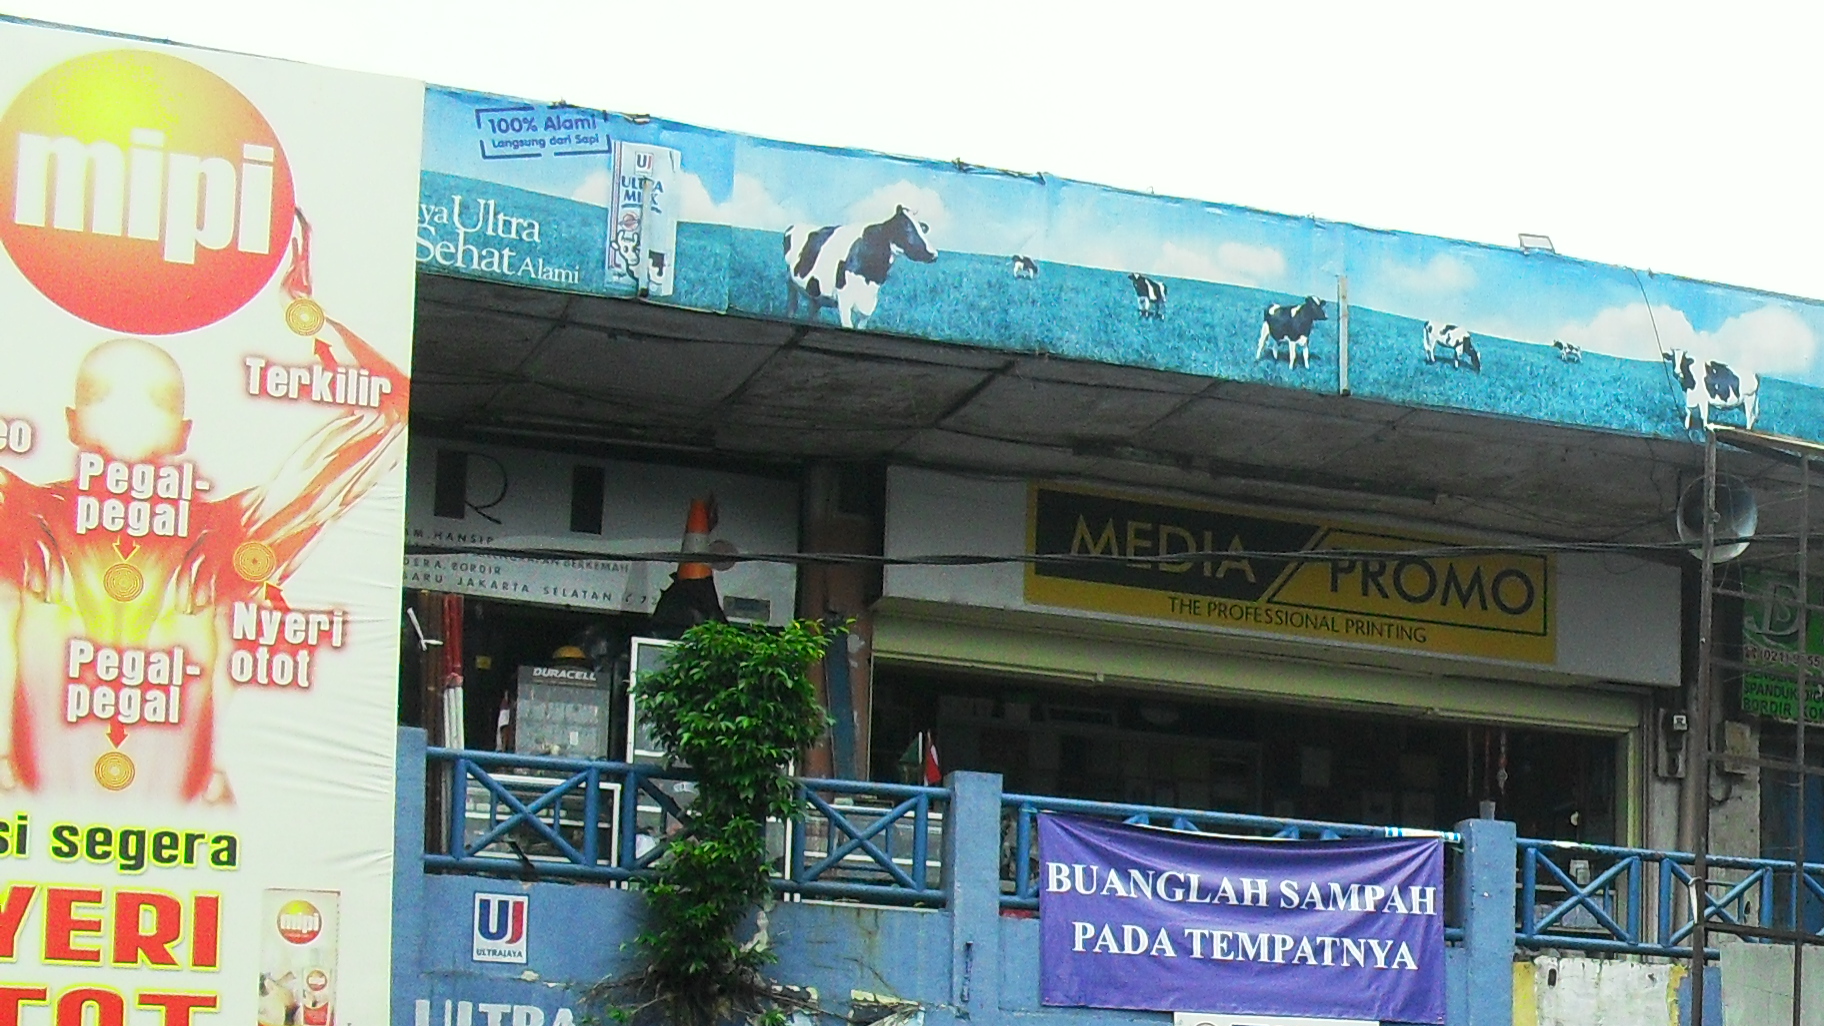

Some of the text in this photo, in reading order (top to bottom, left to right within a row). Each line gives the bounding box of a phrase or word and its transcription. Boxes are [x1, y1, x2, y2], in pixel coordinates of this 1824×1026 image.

[487, 113, 598, 135] 100% Alami
[491, 133, 600, 151] Langsung dari Sapi
[14, 129, 274, 265] mipi
[416, 195, 542, 244] ya Ultra
[623, 190, 658, 206] MIK
[416, 226, 580, 284] Sehat Alami
[244, 355, 392, 409] Terkilir
[77, 452, 211, 502] Pegal-
[75, 495, 189, 538] pegal
[1068, 513, 1258, 584] MEDIA
[457, 576, 530, 594] JAKARTA
[542, 585, 612, 602] SELATAN
[1327, 547, 1535, 616] PROMO
[232, 600, 344, 649] Nyeri
[1167, 596, 1428, 644] THE PROFESSIONAL PRINTING
[67, 640, 201, 687] Pegal-
[231, 649, 310, 689] otot
[532, 666, 597, 682] DURACELL
[66, 686, 180, 725] pegal
[1744, 682, 1797, 700] SPANDUK
[1744, 697, 1792, 716] BORDIR
[50, 822, 239, 872] segera
[1045, 861, 1437, 916] BUANGLAH SAMPAH
[475, 946, 525, 960] ULTRAJAYA
[1071, 920, 1419, 971] PADA TEMPATNYA
